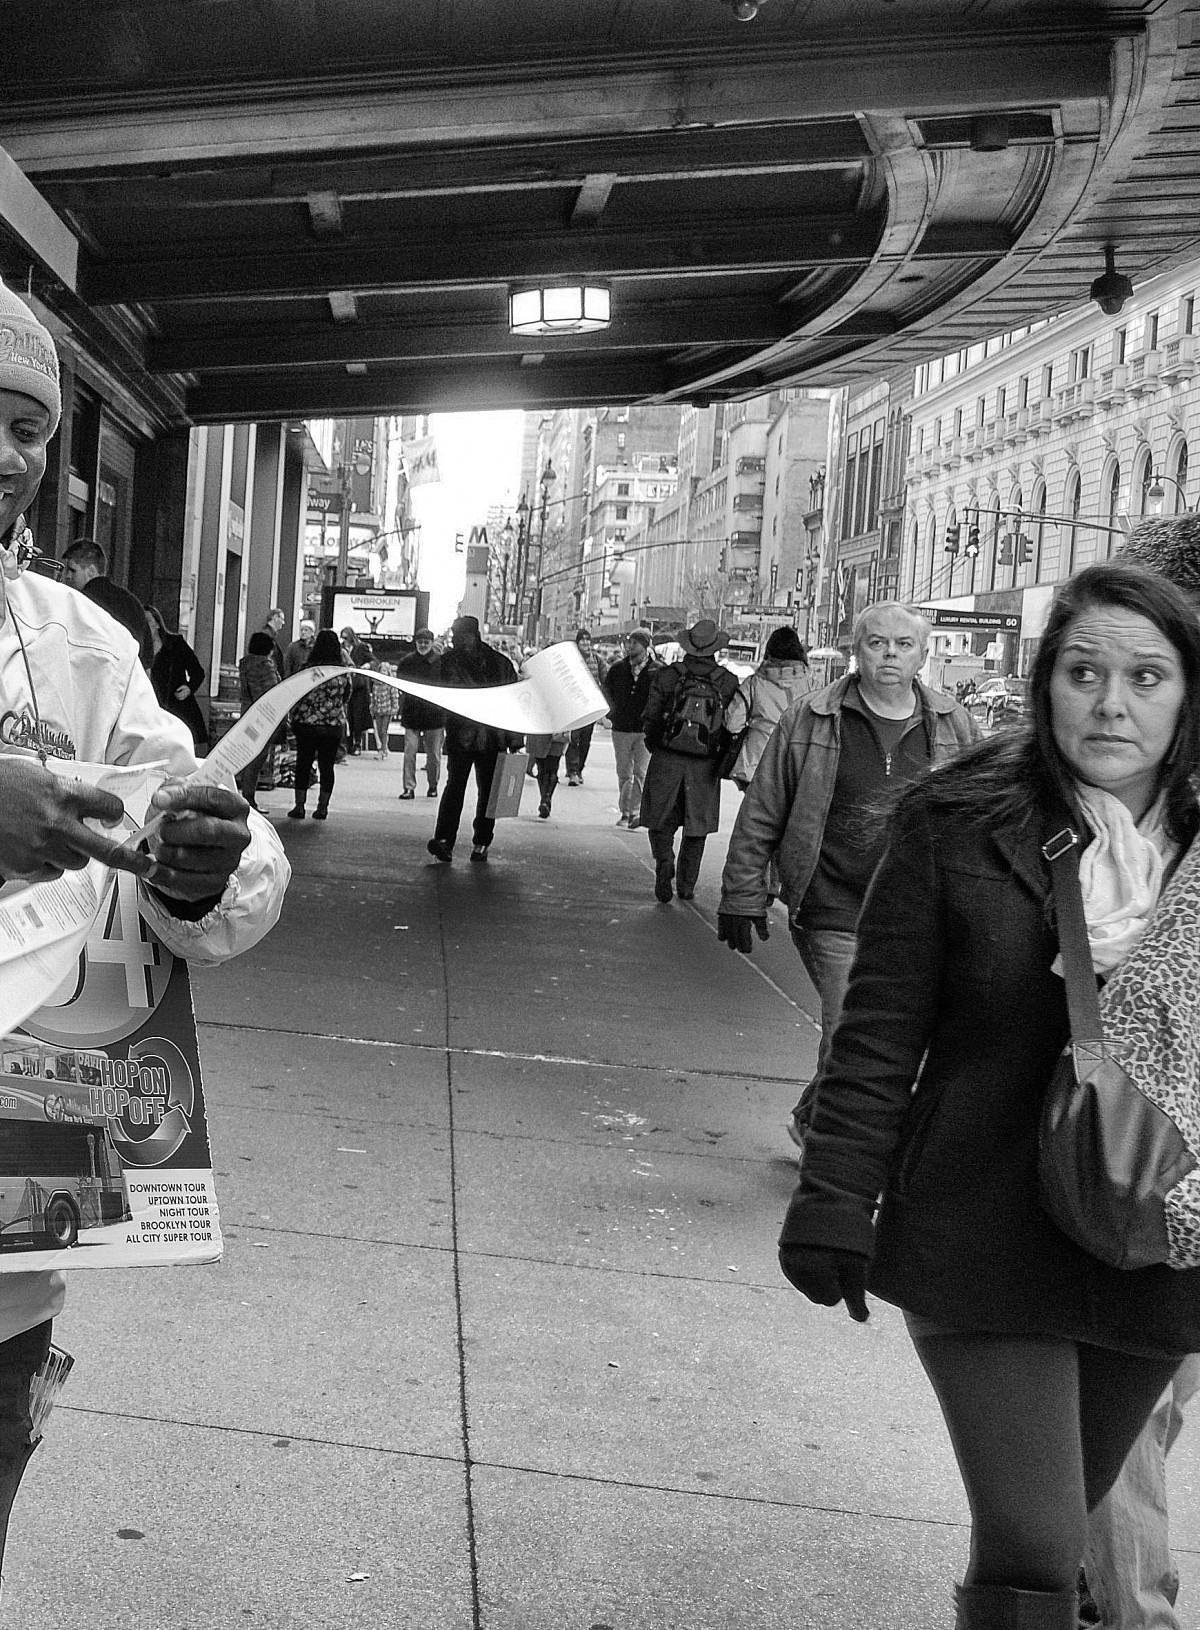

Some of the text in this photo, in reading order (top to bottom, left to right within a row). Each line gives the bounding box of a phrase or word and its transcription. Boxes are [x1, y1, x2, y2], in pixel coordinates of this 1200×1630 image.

[350, 597, 401, 606] UNBROKEN
[940, 615, 959, 623] LUXURY
[959, 616, 978, 624] RENTAL
[978, 617, 1002, 625] BUILDING
[100, 1060, 167, 1094] HOP ON
[89, 1088, 130, 1116] HOP
[128, 1097, 166, 1125] OFF
[129, 1183, 206, 1193] DOWNTOWN TOUR
[148, 1195, 208, 1205] UPTOWN TOUR
[159, 1207, 210, 1217] NIGHT TOUR
[140, 1220, 211, 1230] BROOKLYN TOUR
[126, 1232, 212, 1243] ALL CITY SUPER TOUR
